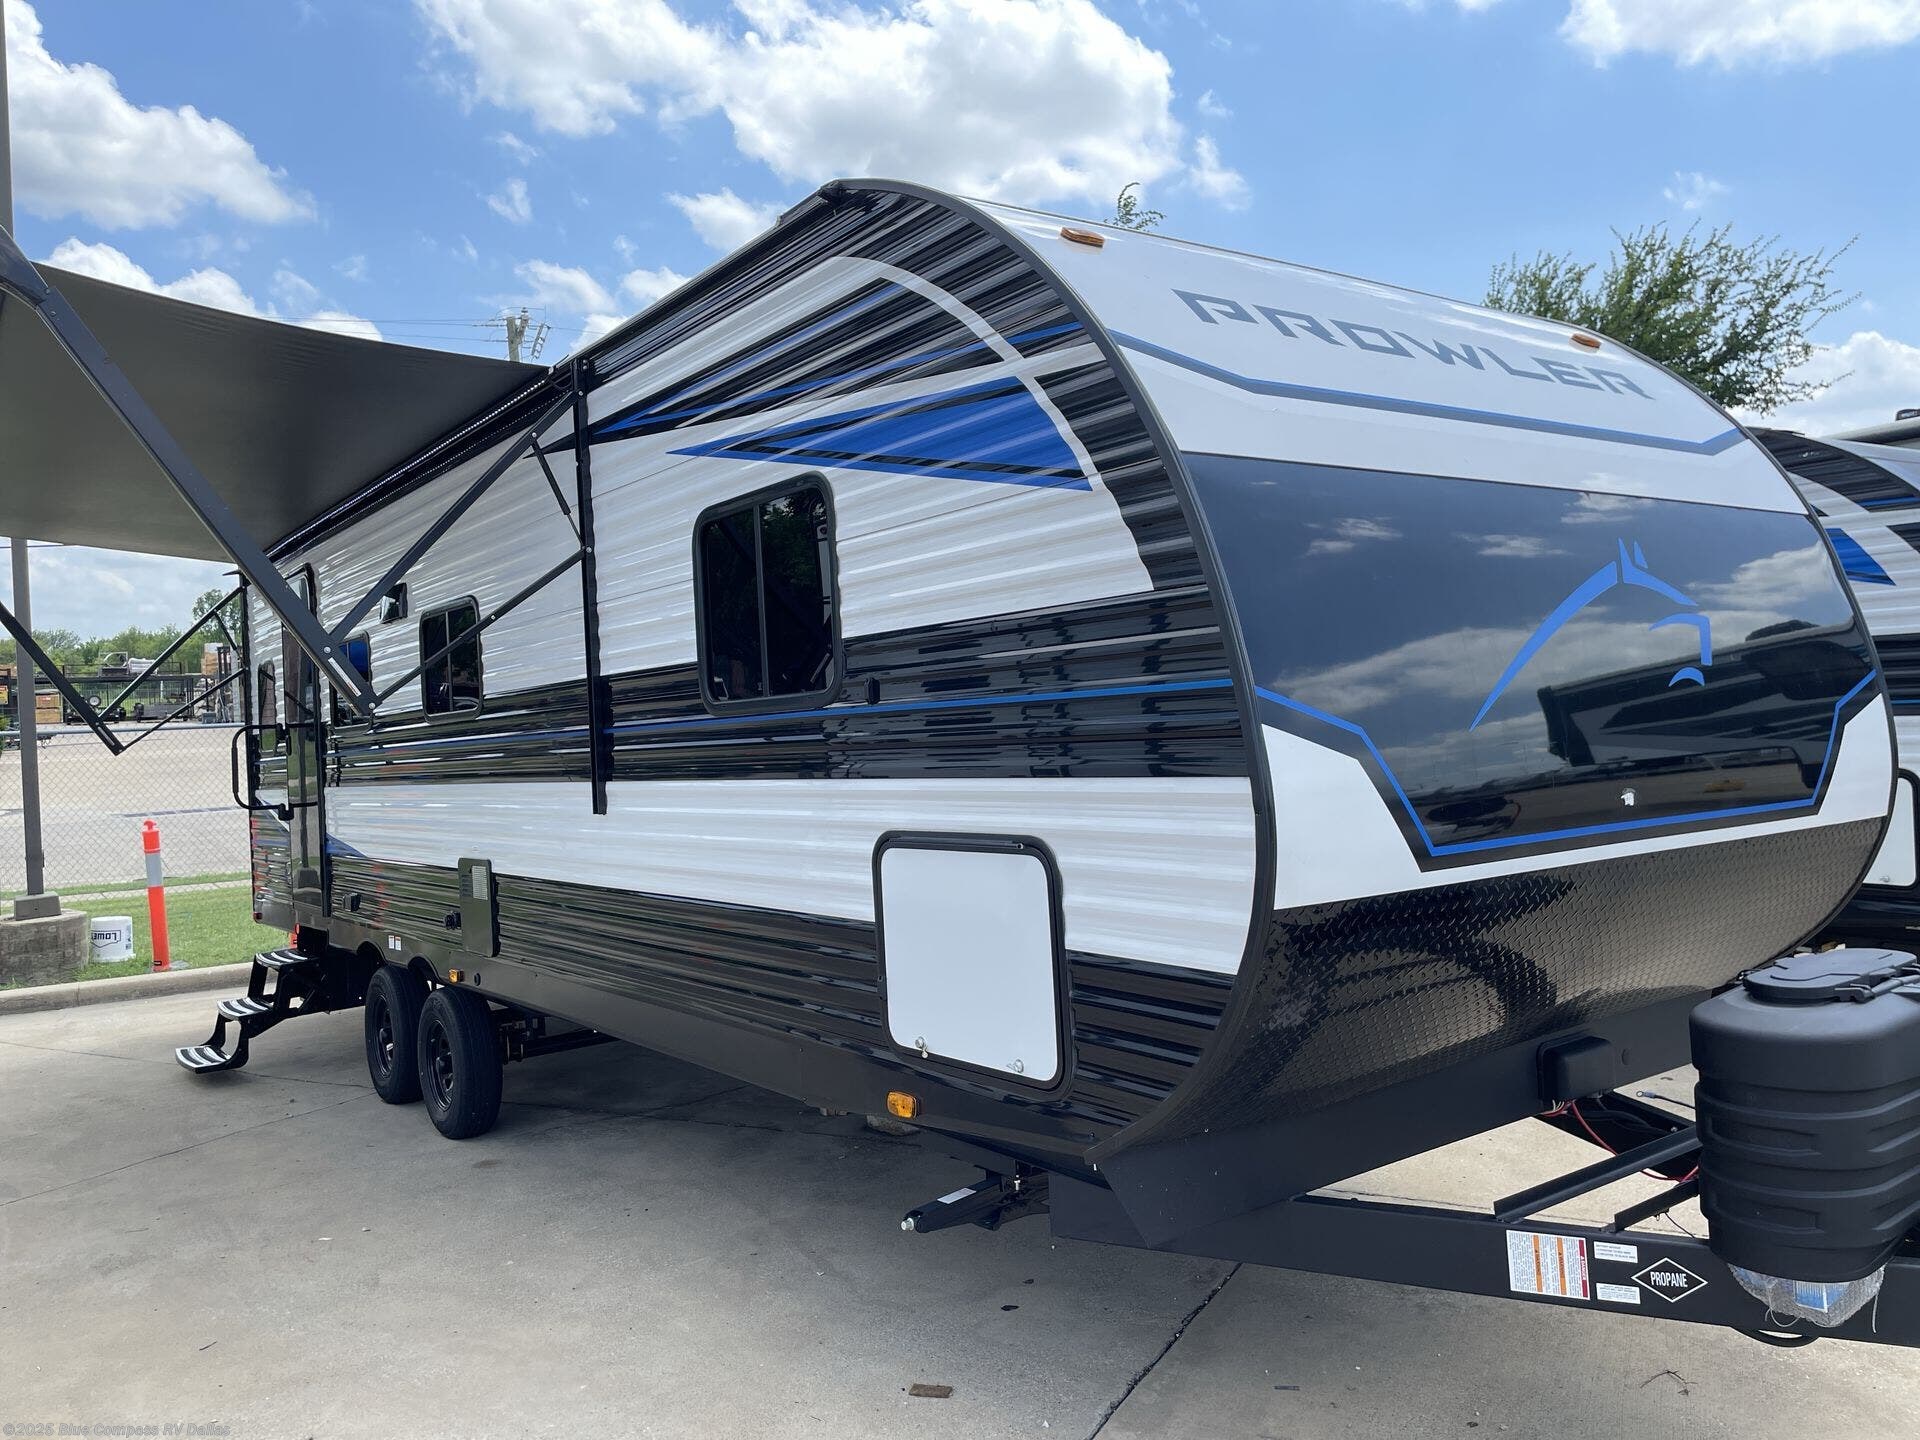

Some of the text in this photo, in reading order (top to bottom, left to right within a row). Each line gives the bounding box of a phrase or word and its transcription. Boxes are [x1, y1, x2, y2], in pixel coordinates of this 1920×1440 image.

[1171, 288, 1656, 400] PROWLER
[92, 932, 117, 941] LOWE
[1650, 1271, 1688, 1288] PROPANE
